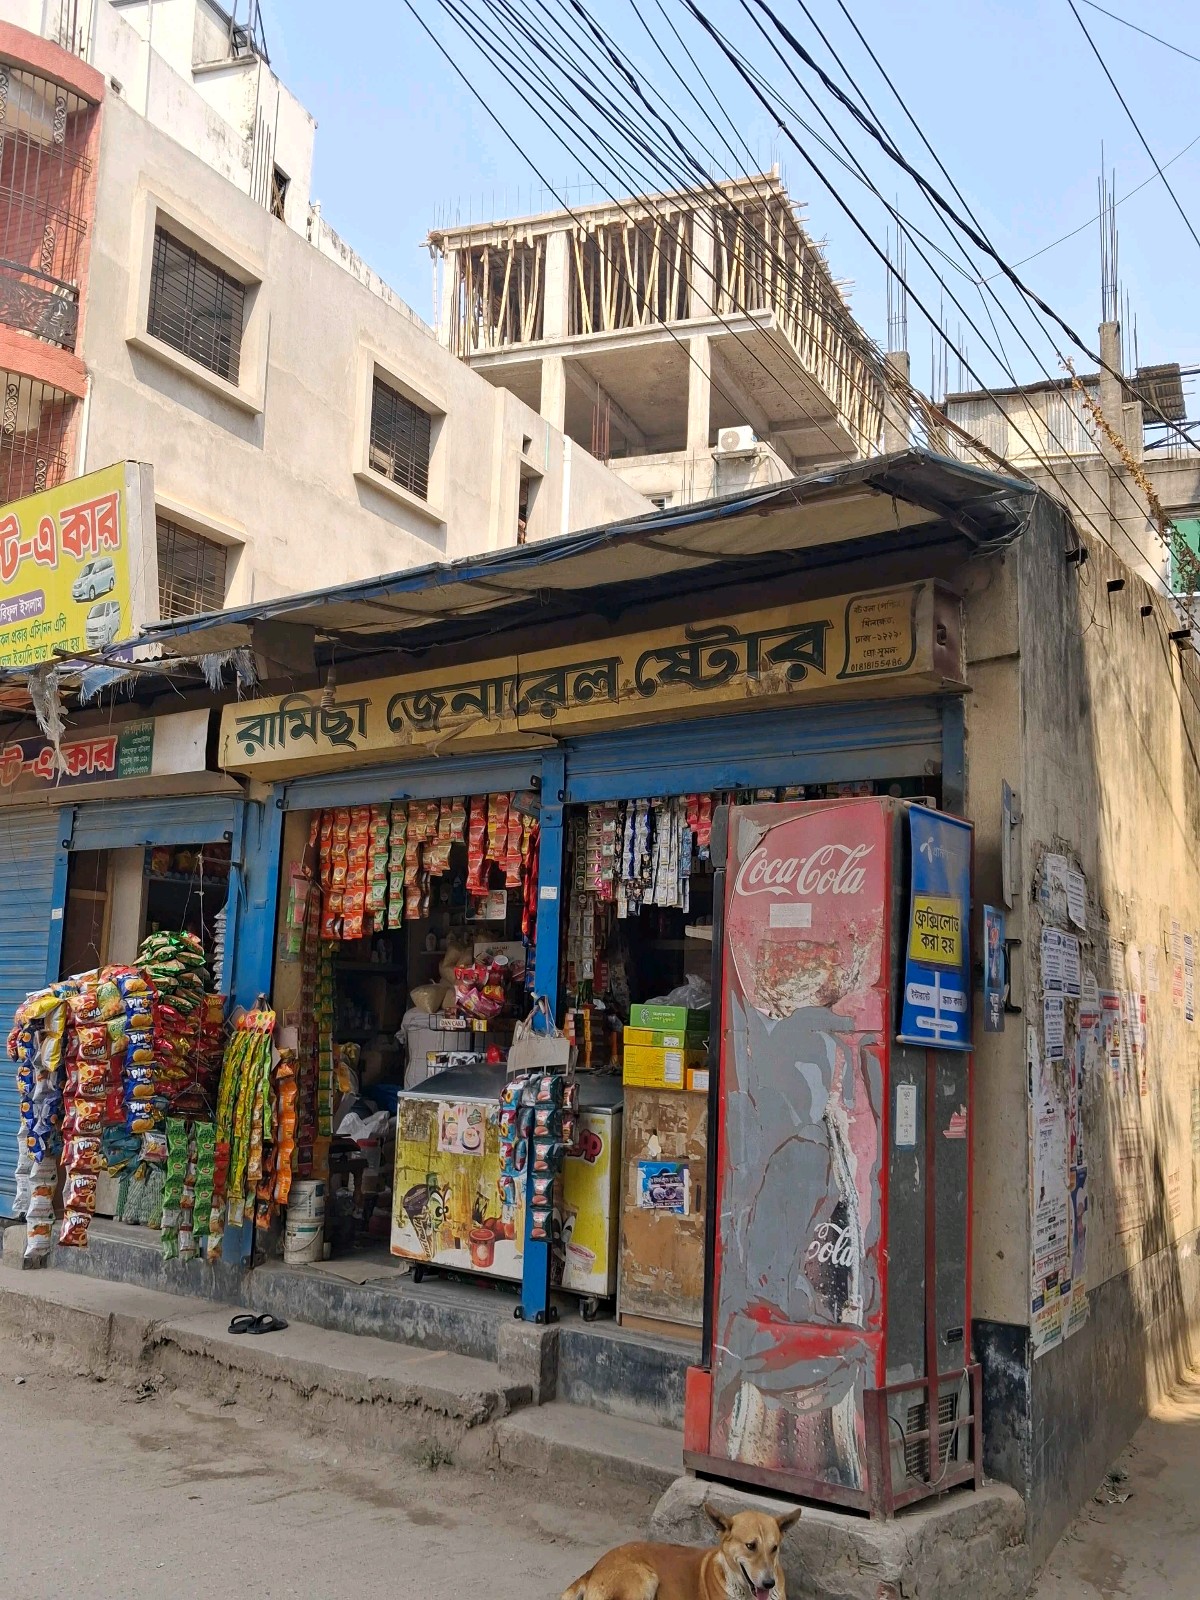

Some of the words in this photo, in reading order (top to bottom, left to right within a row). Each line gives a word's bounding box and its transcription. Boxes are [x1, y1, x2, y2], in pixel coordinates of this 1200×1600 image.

[60, 490, 120, 559] কার
[19, 596, 43, 616] ইসলাম
[12, 628, 28, 643] প্রকার
[54, 612, 67, 632] এসি
[235, 693, 372, 757] রামিছা
[387, 656, 624, 733] জেনারেল
[735, 843, 876, 897] Coca-Cola
[921, 933, 939, 951] করা
[941, 937, 954, 954] হয়
